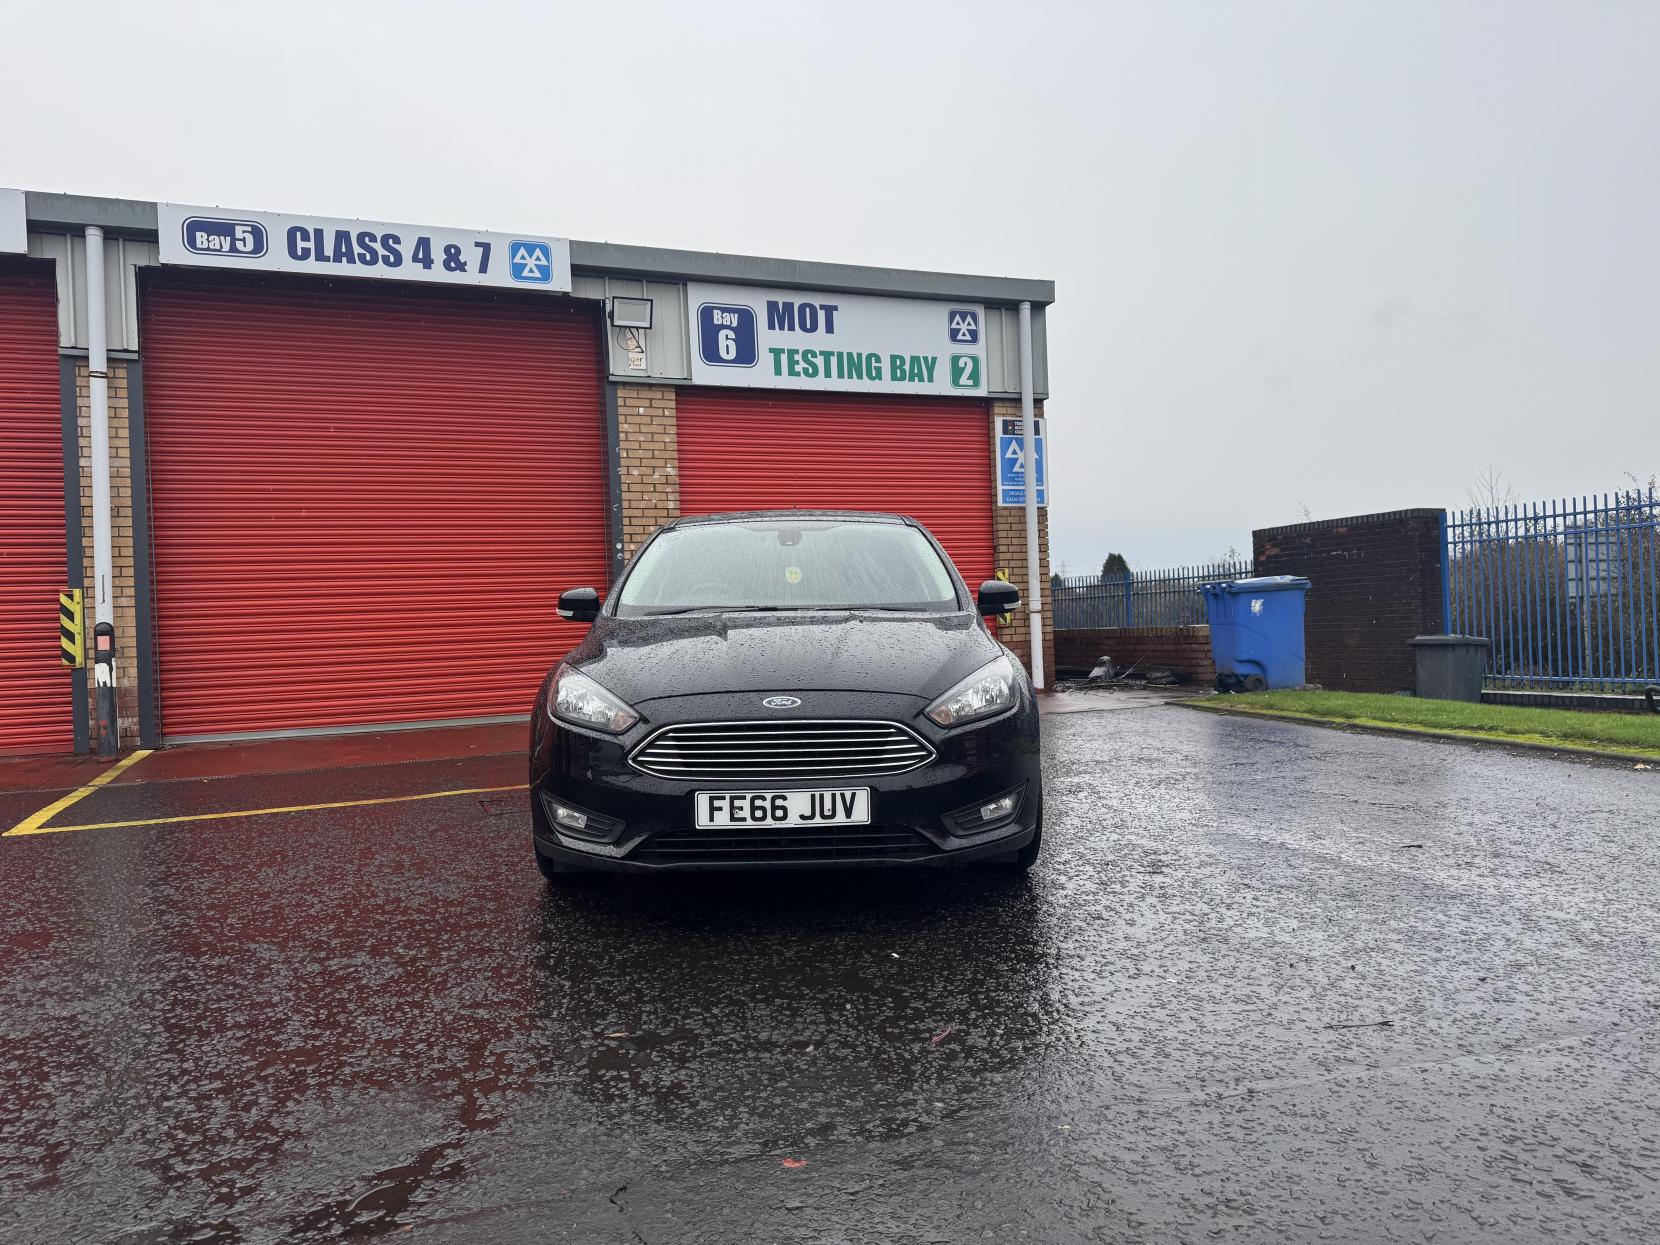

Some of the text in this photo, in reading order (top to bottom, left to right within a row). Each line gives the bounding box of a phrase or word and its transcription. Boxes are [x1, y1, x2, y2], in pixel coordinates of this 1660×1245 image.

[195, 225, 254, 252] Bay 5
[286, 225, 491, 274] CLASS 4 & 7
[713, 309, 739, 327] Bay
[766, 300, 839, 335] MOT
[718, 329, 737, 360] 6
[768, 347, 974, 386] TESTING BAY 2
[708, 792, 857, 823] FE66 JUV
